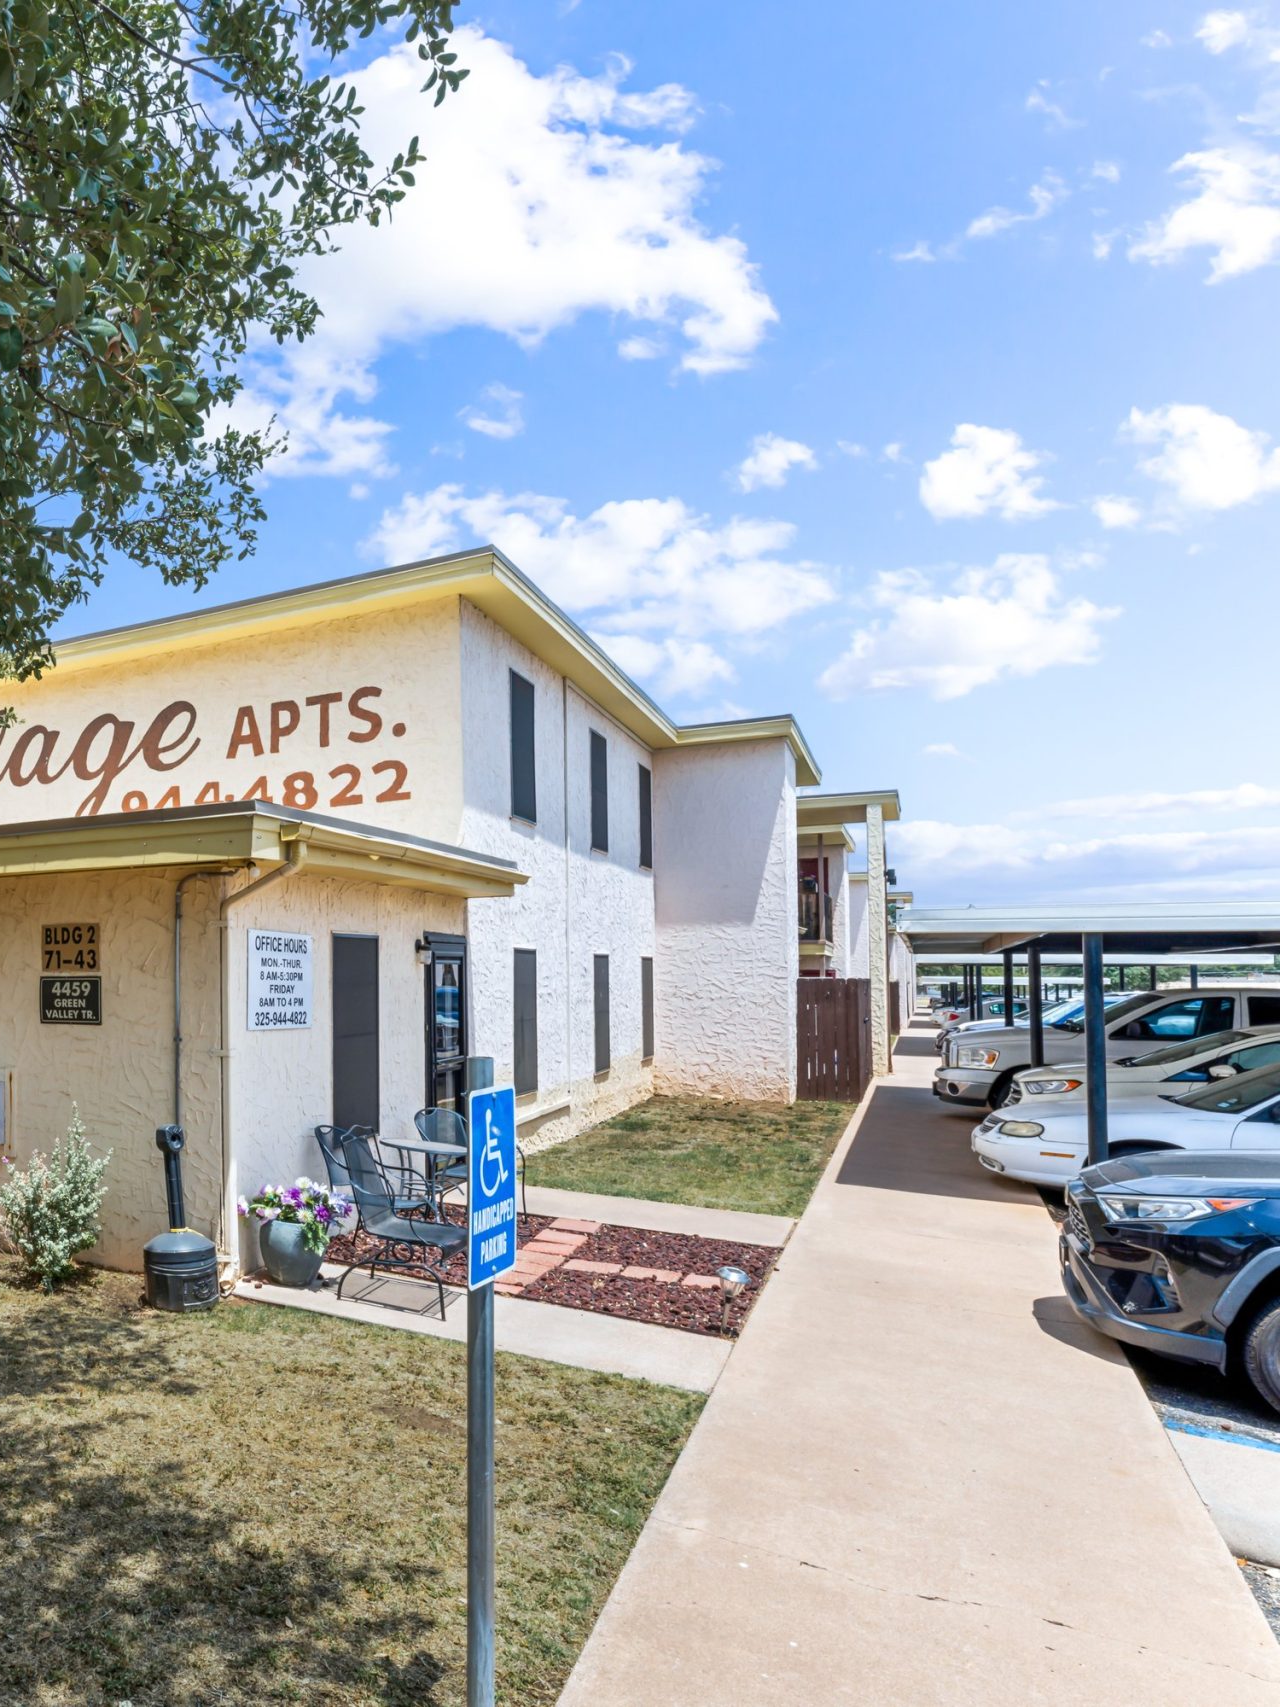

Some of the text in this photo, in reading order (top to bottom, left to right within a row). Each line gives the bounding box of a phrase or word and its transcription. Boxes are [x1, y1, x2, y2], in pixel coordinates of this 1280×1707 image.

[226, 686, 407, 759] APTS.
[45, 926, 96, 945] BLDG 2
[255, 935, 308, 955] OFFICE HOURS
[44, 949, 97, 969] 71-43
[51, 981, 91, 997] 4459
[269, 984, 295, 994] FRIDAY
[54, 998, 86, 1008] GREEN
[259, 997, 304, 1007] 8AM TO 4 PM
[45, 1009, 96, 1020] VALLEY TR.
[254, 1011, 307, 1026] 325-944-4822
[473, 1197, 514, 1235] HANDICAPPED
[480, 1231, 507, 1265] PARKING
